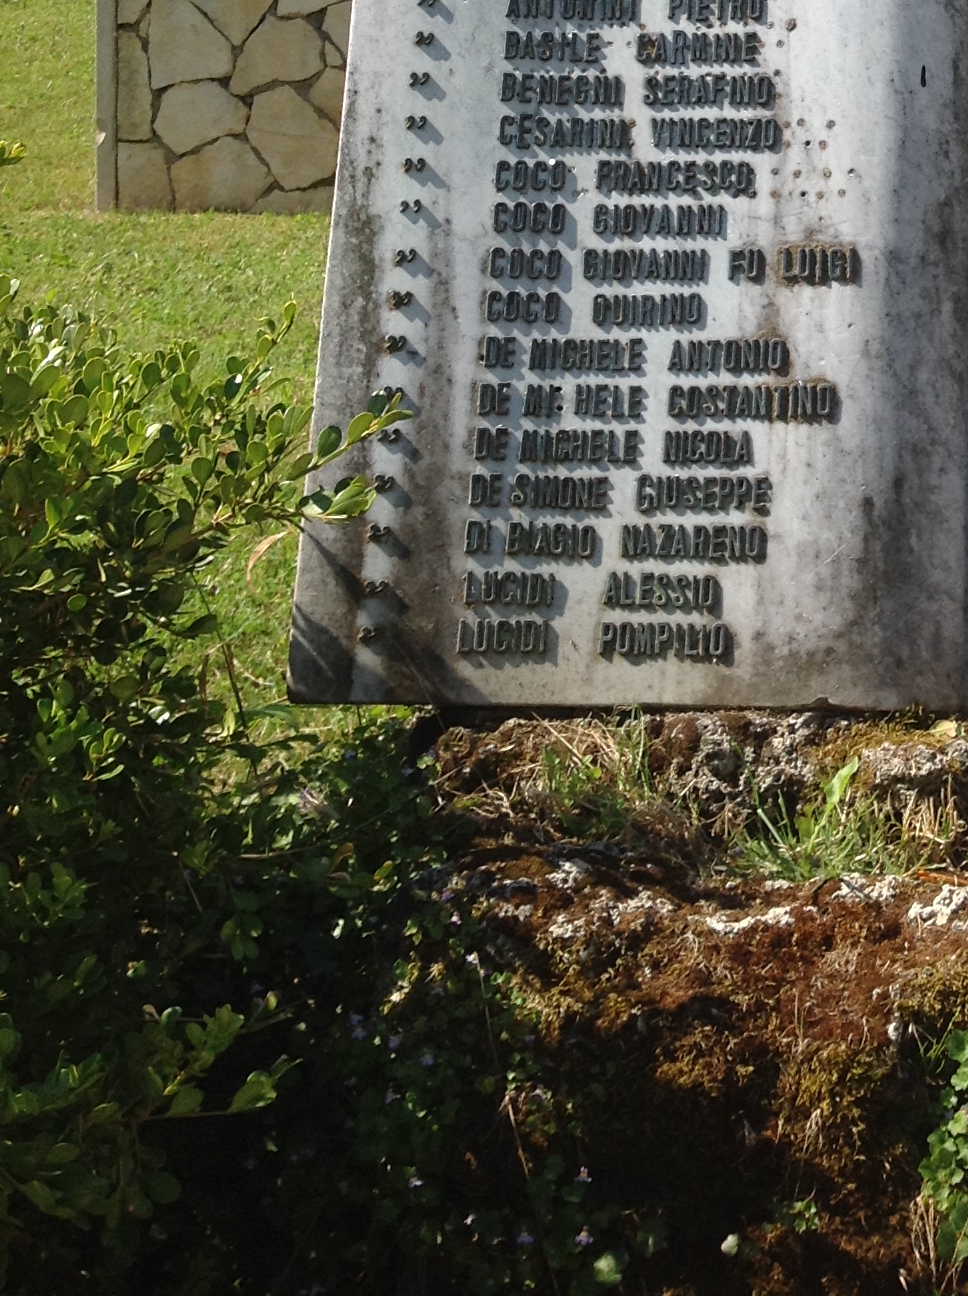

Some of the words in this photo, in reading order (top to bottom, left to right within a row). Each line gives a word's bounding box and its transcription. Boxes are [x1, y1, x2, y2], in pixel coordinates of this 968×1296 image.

[503, 30, 601, 63] BASILE
[635, 30, 760, 65] CARMINE
[643, 74, 776, 105] SERAFINO
[499, 113, 627, 149] CESARINI
[650, 117, 780, 148] VINCENZO
[495, 160, 567, 191] COCO
[596, 159, 754, 192] FRANCESCO
[493, 202, 566, 234] COCO
[592, 203, 725, 235] GIOVANNI
[489, 247, 563, 280] COCO
[583, 248, 709, 281] GIOVANNI
[728, 247, 764, 280] FU
[781, 247, 856, 281] LUIGI
[485, 290, 561, 323] COCO
[592, 292, 703, 326] QUIRINO
[484, 336, 516, 368] DE
[528, 337, 643, 371] MICHELE
[667, 337, 788, 371] ANTONIO
[478, 382, 511, 416] DE
[668, 384, 836, 421] COSTANTINO
[474, 426, 509, 460] DE
[520, 429, 639, 463] MICHELE
[663, 429, 750, 463] NICOLA
[468, 472, 503, 506] DE
[511, 473, 609, 509] SIMONE
[635, 473, 772, 511] GIUSEPPE
[464, 518, 492, 554] DI
[506, 520, 597, 558] BIAGIO
[621, 523, 763, 558] NAZARENO
[462, 570, 556, 604] LUCIDI
[603, 571, 718, 606] ALESSIO
[457, 618, 550, 654] LUCIDI
[599, 621, 728, 656] POMPILIO
